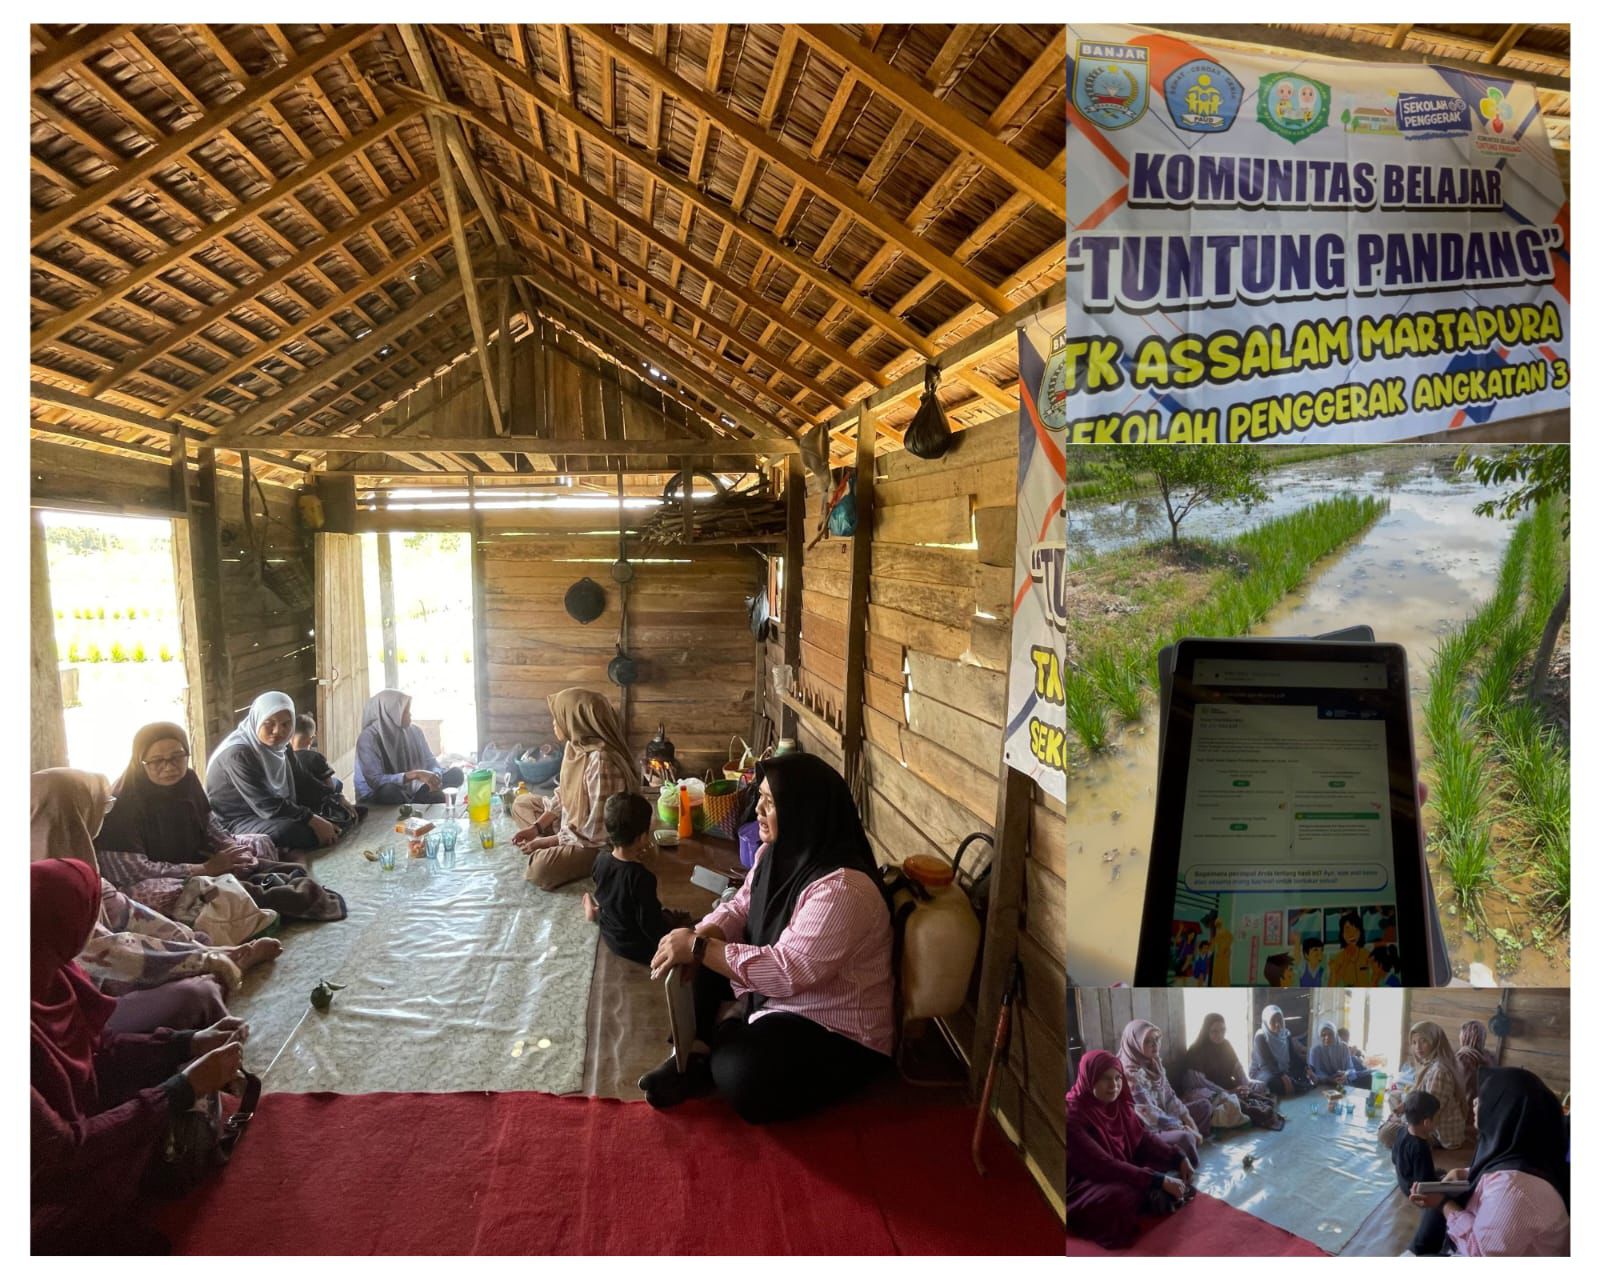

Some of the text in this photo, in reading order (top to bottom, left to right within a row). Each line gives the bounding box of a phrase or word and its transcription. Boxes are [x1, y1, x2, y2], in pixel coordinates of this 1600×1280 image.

[1082, 45, 1146, 60] BANJAR
[1403, 99, 1448, 114] SEKOLAH
[1404, 112, 1462, 127] PENGGERAK
[1132, 152, 1503, 208] KOMUNITAS BELAJAR
[1066, 303, 1562, 390] TK ASSALAM MARTAPURA
[1066, 359, 1569, 443] EKOLAH PENGGERAK ANGKATAN 3
